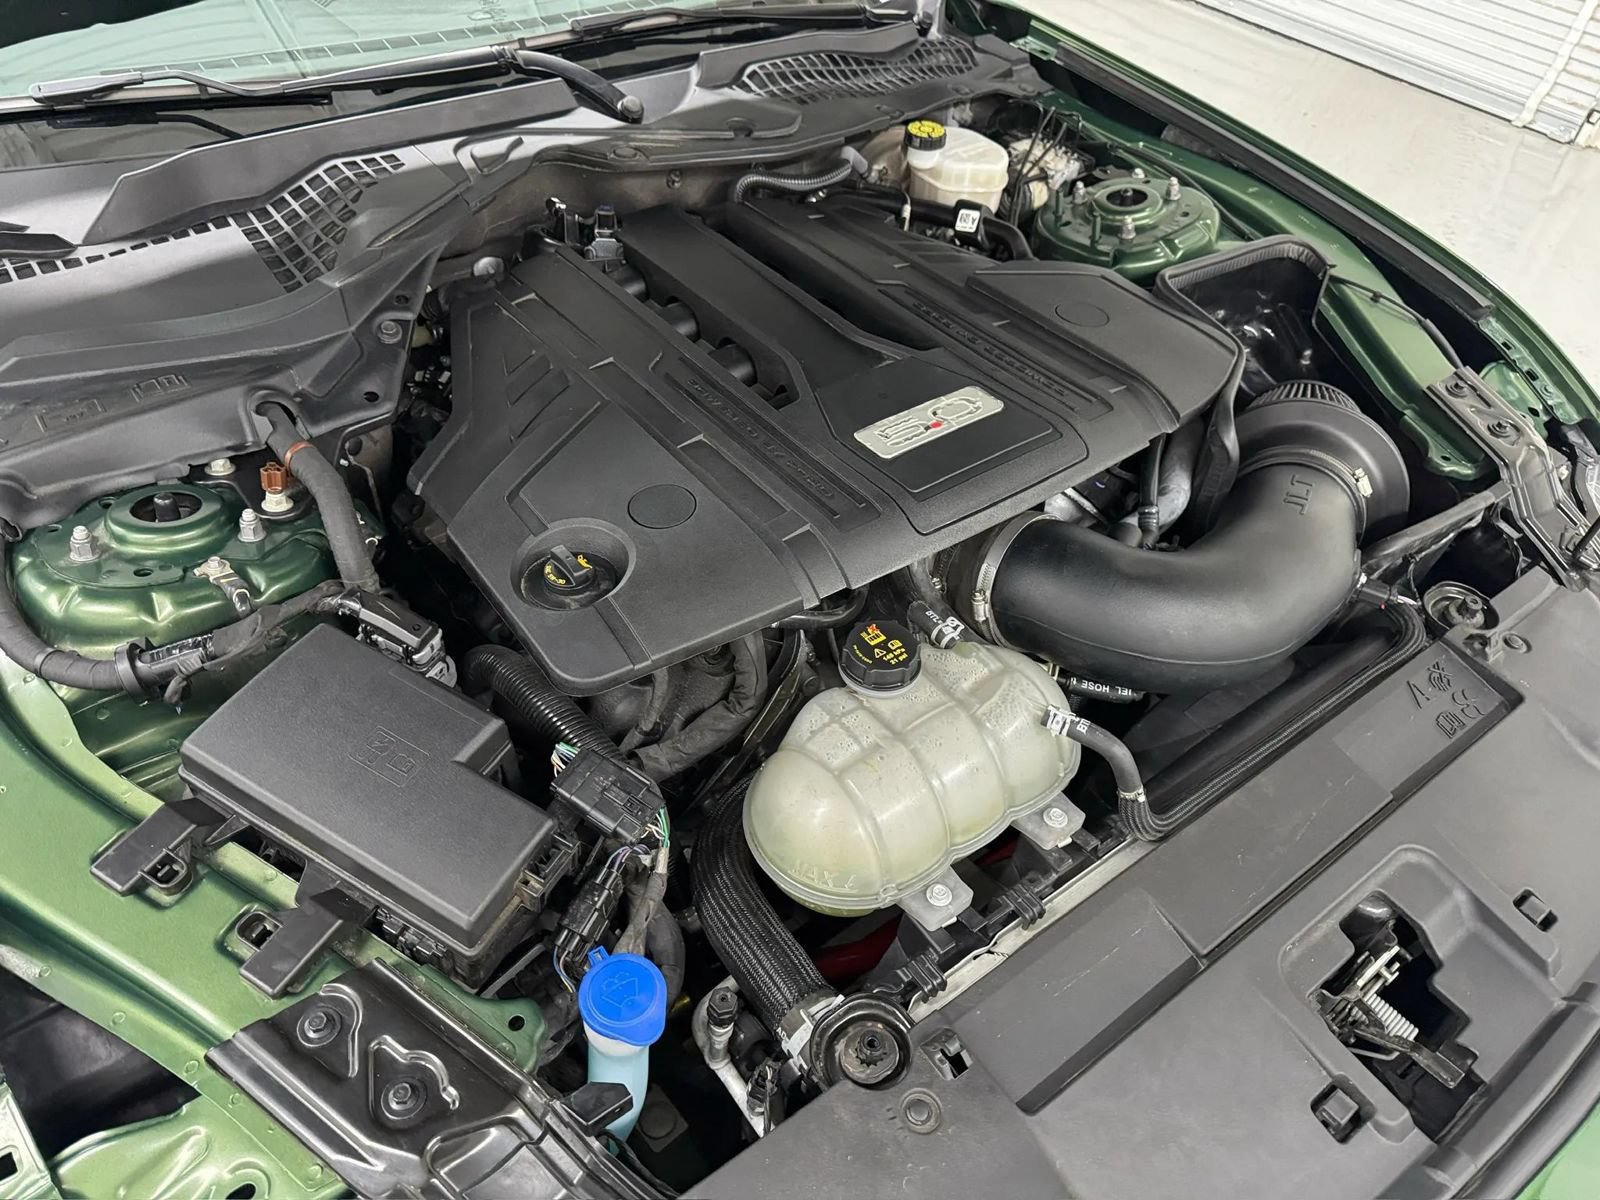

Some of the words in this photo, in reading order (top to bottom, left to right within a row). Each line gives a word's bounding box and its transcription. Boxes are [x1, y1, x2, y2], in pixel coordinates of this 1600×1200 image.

[874, 396, 984, 447] 5.0
[1283, 474, 1313, 516] JLT
[1081, 679, 1110, 693] HOSE
